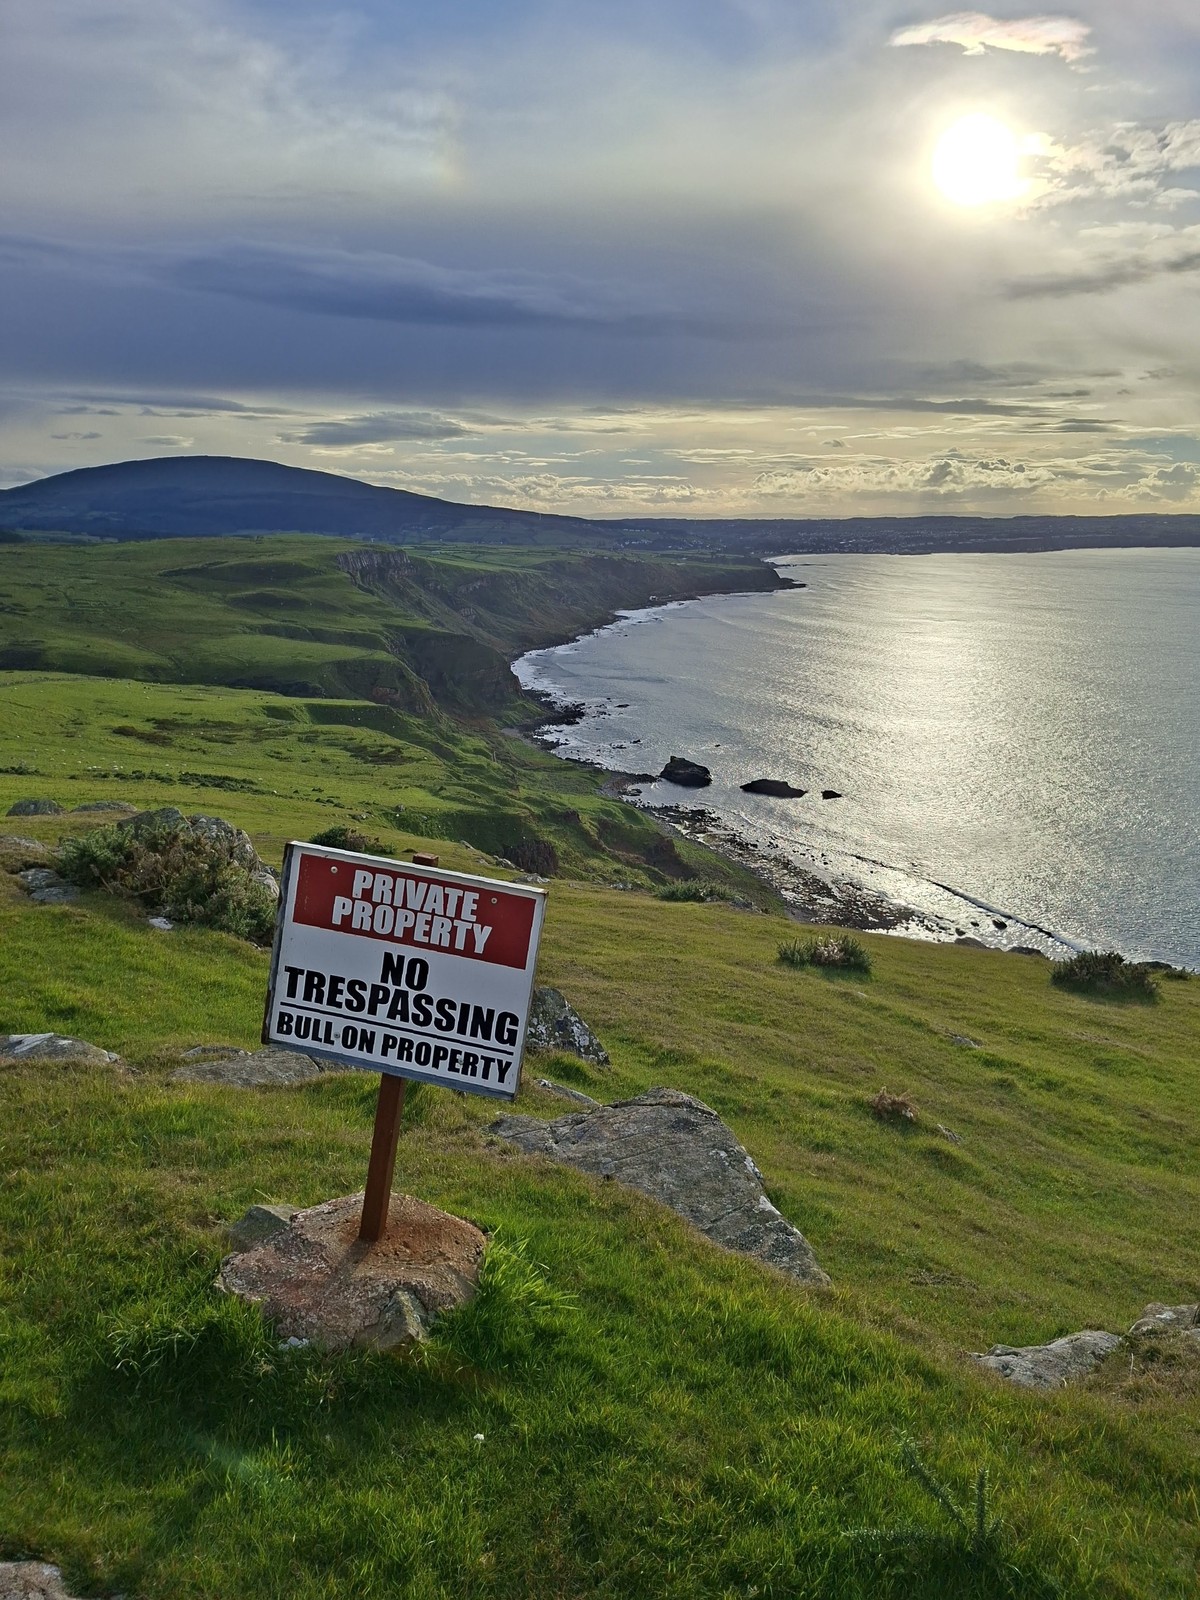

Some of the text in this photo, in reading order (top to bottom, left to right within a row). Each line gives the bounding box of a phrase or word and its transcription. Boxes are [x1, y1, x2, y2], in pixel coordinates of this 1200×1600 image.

[331, 895, 493, 954] PROPERTY
[352, 869, 480, 922] PRIVATE
[380, 951, 429, 991] NO
[284, 965, 520, 1047] TRESPASSING
[276, 1011, 513, 1084] BULL ON PROPERTY
